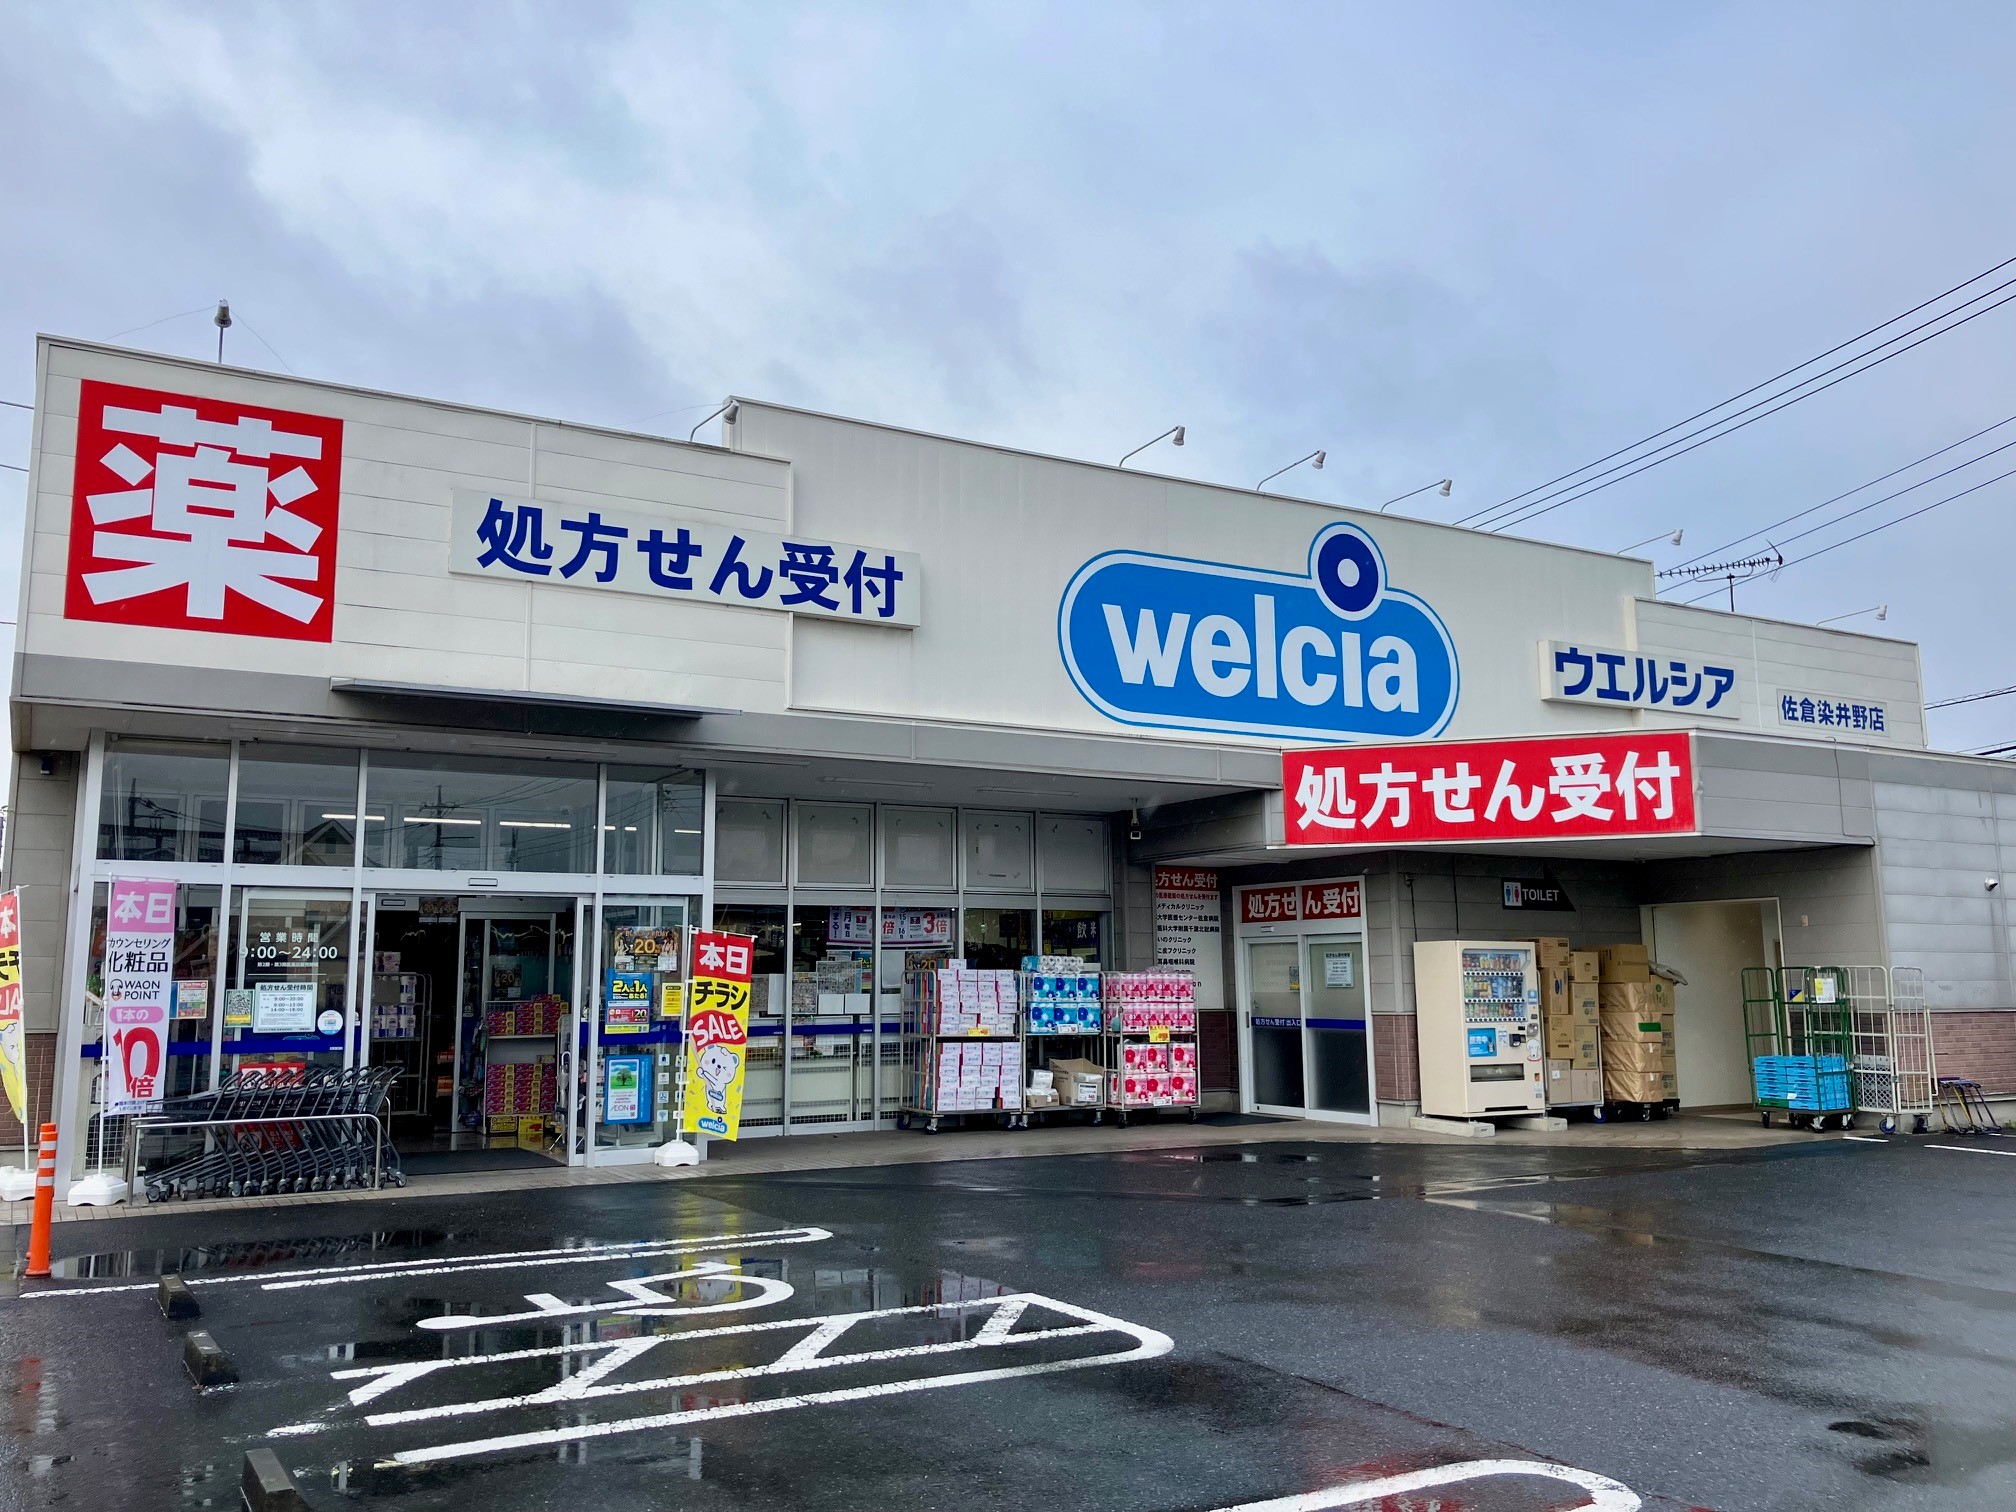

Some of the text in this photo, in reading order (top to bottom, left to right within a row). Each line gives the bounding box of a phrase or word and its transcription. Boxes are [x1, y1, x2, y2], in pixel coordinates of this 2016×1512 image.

[81, 404, 324, 625] 薬
[477, 498, 904, 618] 処方せん受付
[1102, 594, 1420, 715] welcia
[1554, 646, 1735, 709] ウエルシア
[1781, 694, 1886, 733] 佐倉染井野店
[1295, 750, 1683, 831] 処方せん受付
[113, 890, 173, 924] 本日
[1248, 887, 1360, 919] 処方せん受付
[1522, 888, 1559, 902] TOILET
[1156, 914, 1219, 922] 大学医療センター佐倉病院
[109, 937, 171, 949] カウンセリング
[259, 932, 319, 943] 営業時間
[109, 951, 169, 973] 化粧品
[699, 941, 748, 975] 本日
[124, 980, 160, 990] WAON
[124, 990, 160, 1000] POINT
[694, 980, 748, 1011] チラシ
[692, 1015, 744, 1047] SALE
[701, 1119, 726, 1132] welcia
